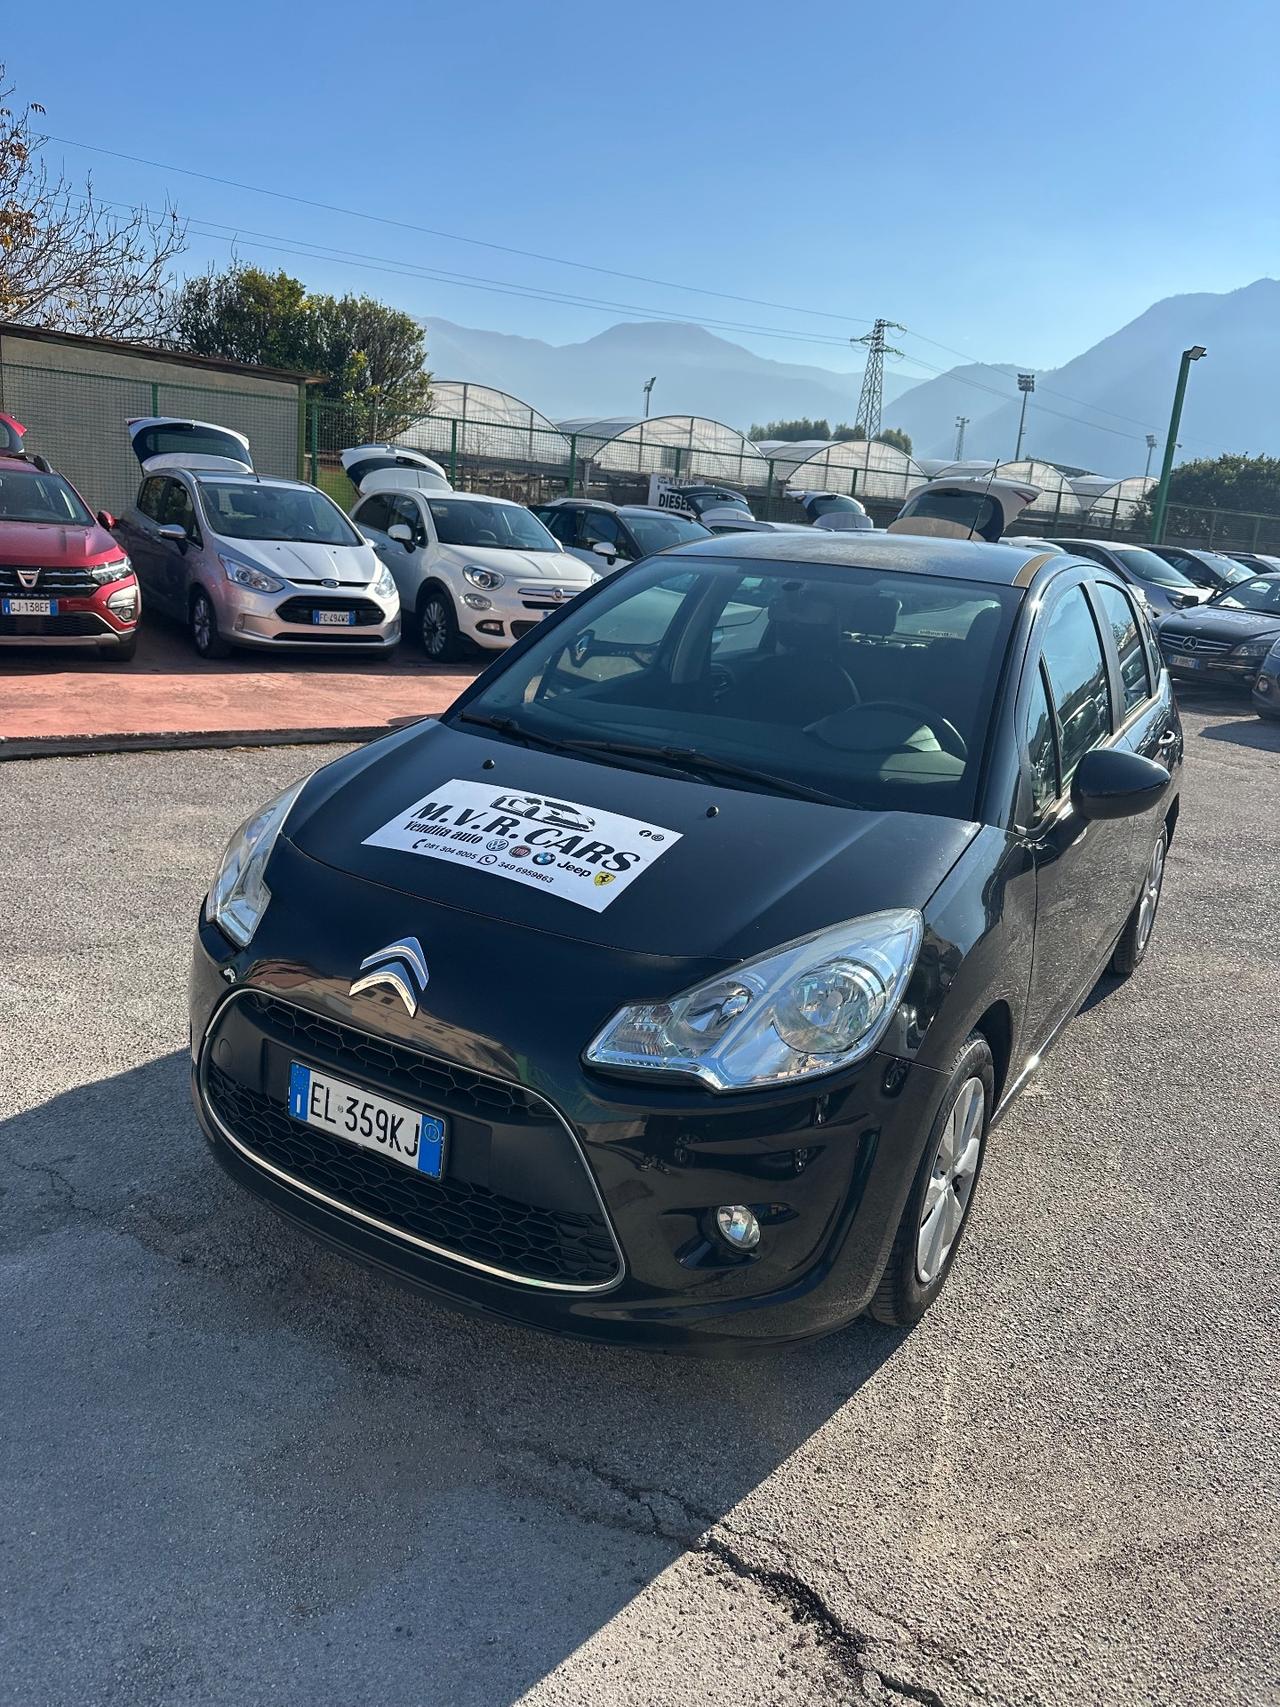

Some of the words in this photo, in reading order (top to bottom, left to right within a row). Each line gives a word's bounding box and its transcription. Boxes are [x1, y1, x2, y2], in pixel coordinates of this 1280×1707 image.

[404, 820, 452, 838] Vendita
[450, 830, 483, 845] auto
[410, 802, 519, 839] M.V.R.
[524, 828, 641, 872] CARS
[440, 847, 457, 855] 304
[455, 850, 478, 860] 8005
[498, 861, 516, 871] 349
[515, 867, 554, 884] 6959863
[557, 861, 592, 878] Jeep
[344, 1095, 420, 1158] 359KJ
